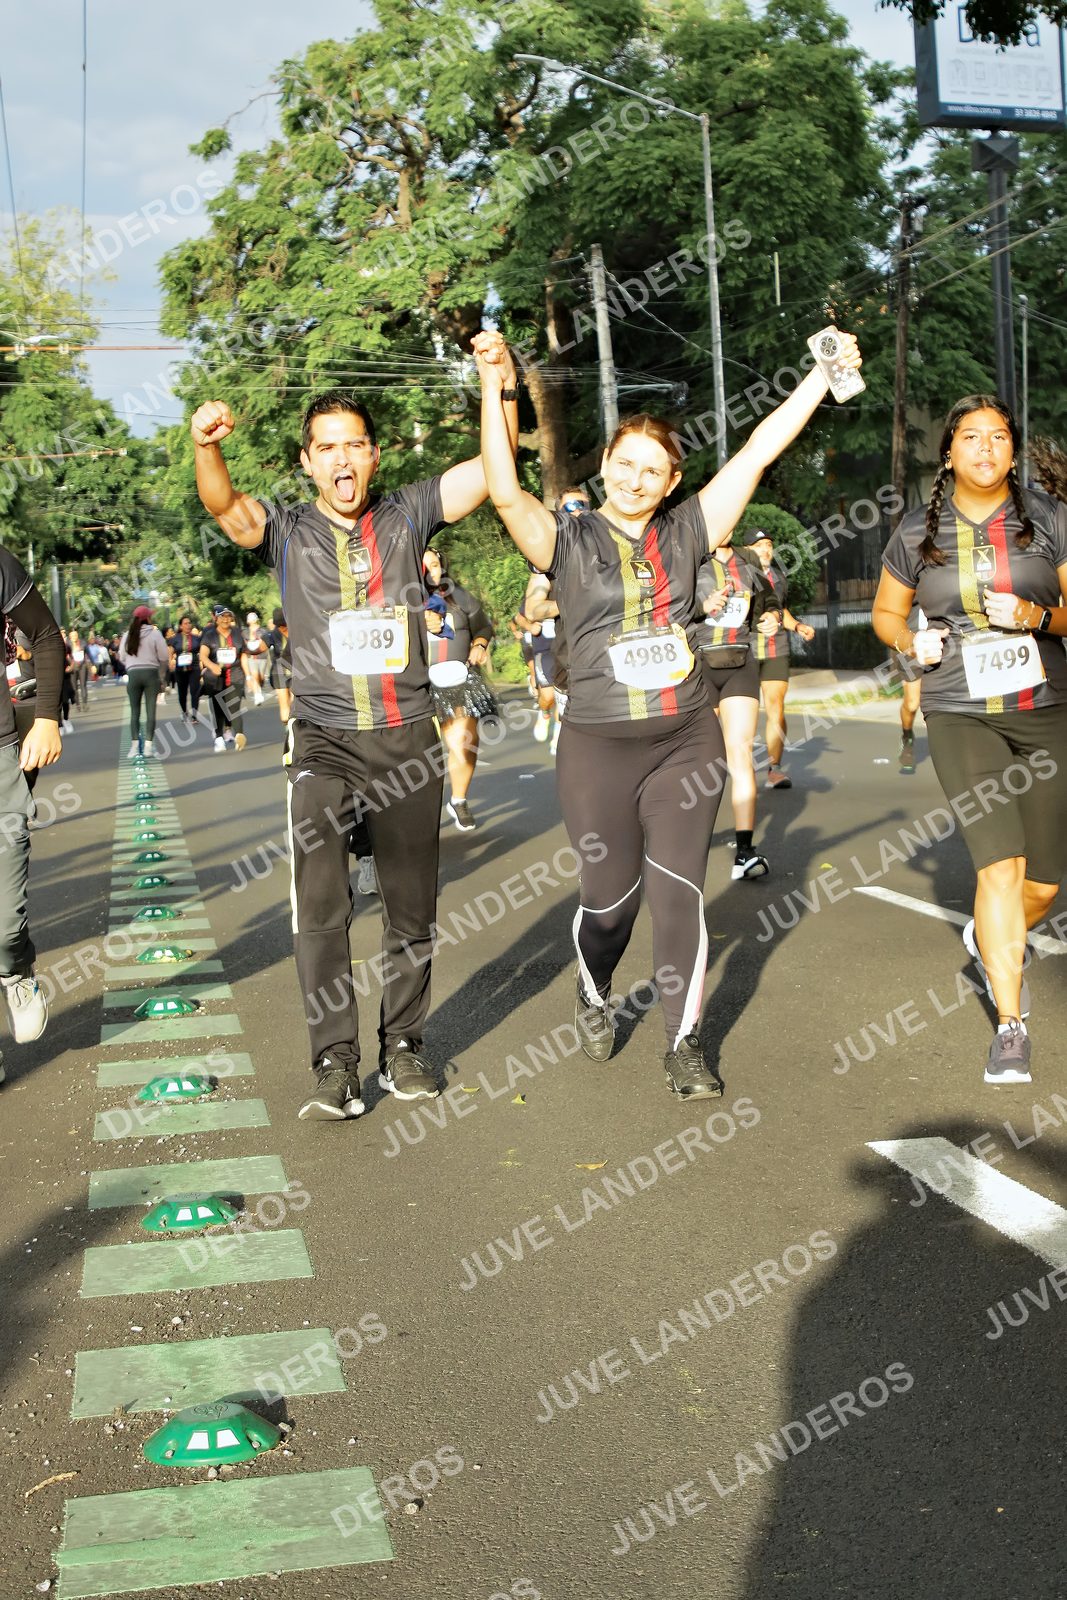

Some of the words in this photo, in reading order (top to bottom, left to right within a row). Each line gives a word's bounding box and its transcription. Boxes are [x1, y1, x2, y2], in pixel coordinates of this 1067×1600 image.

[342, 628, 394, 651] 4989
[623, 642, 678, 668] 4988
[975, 644, 1031, 675] 7499
